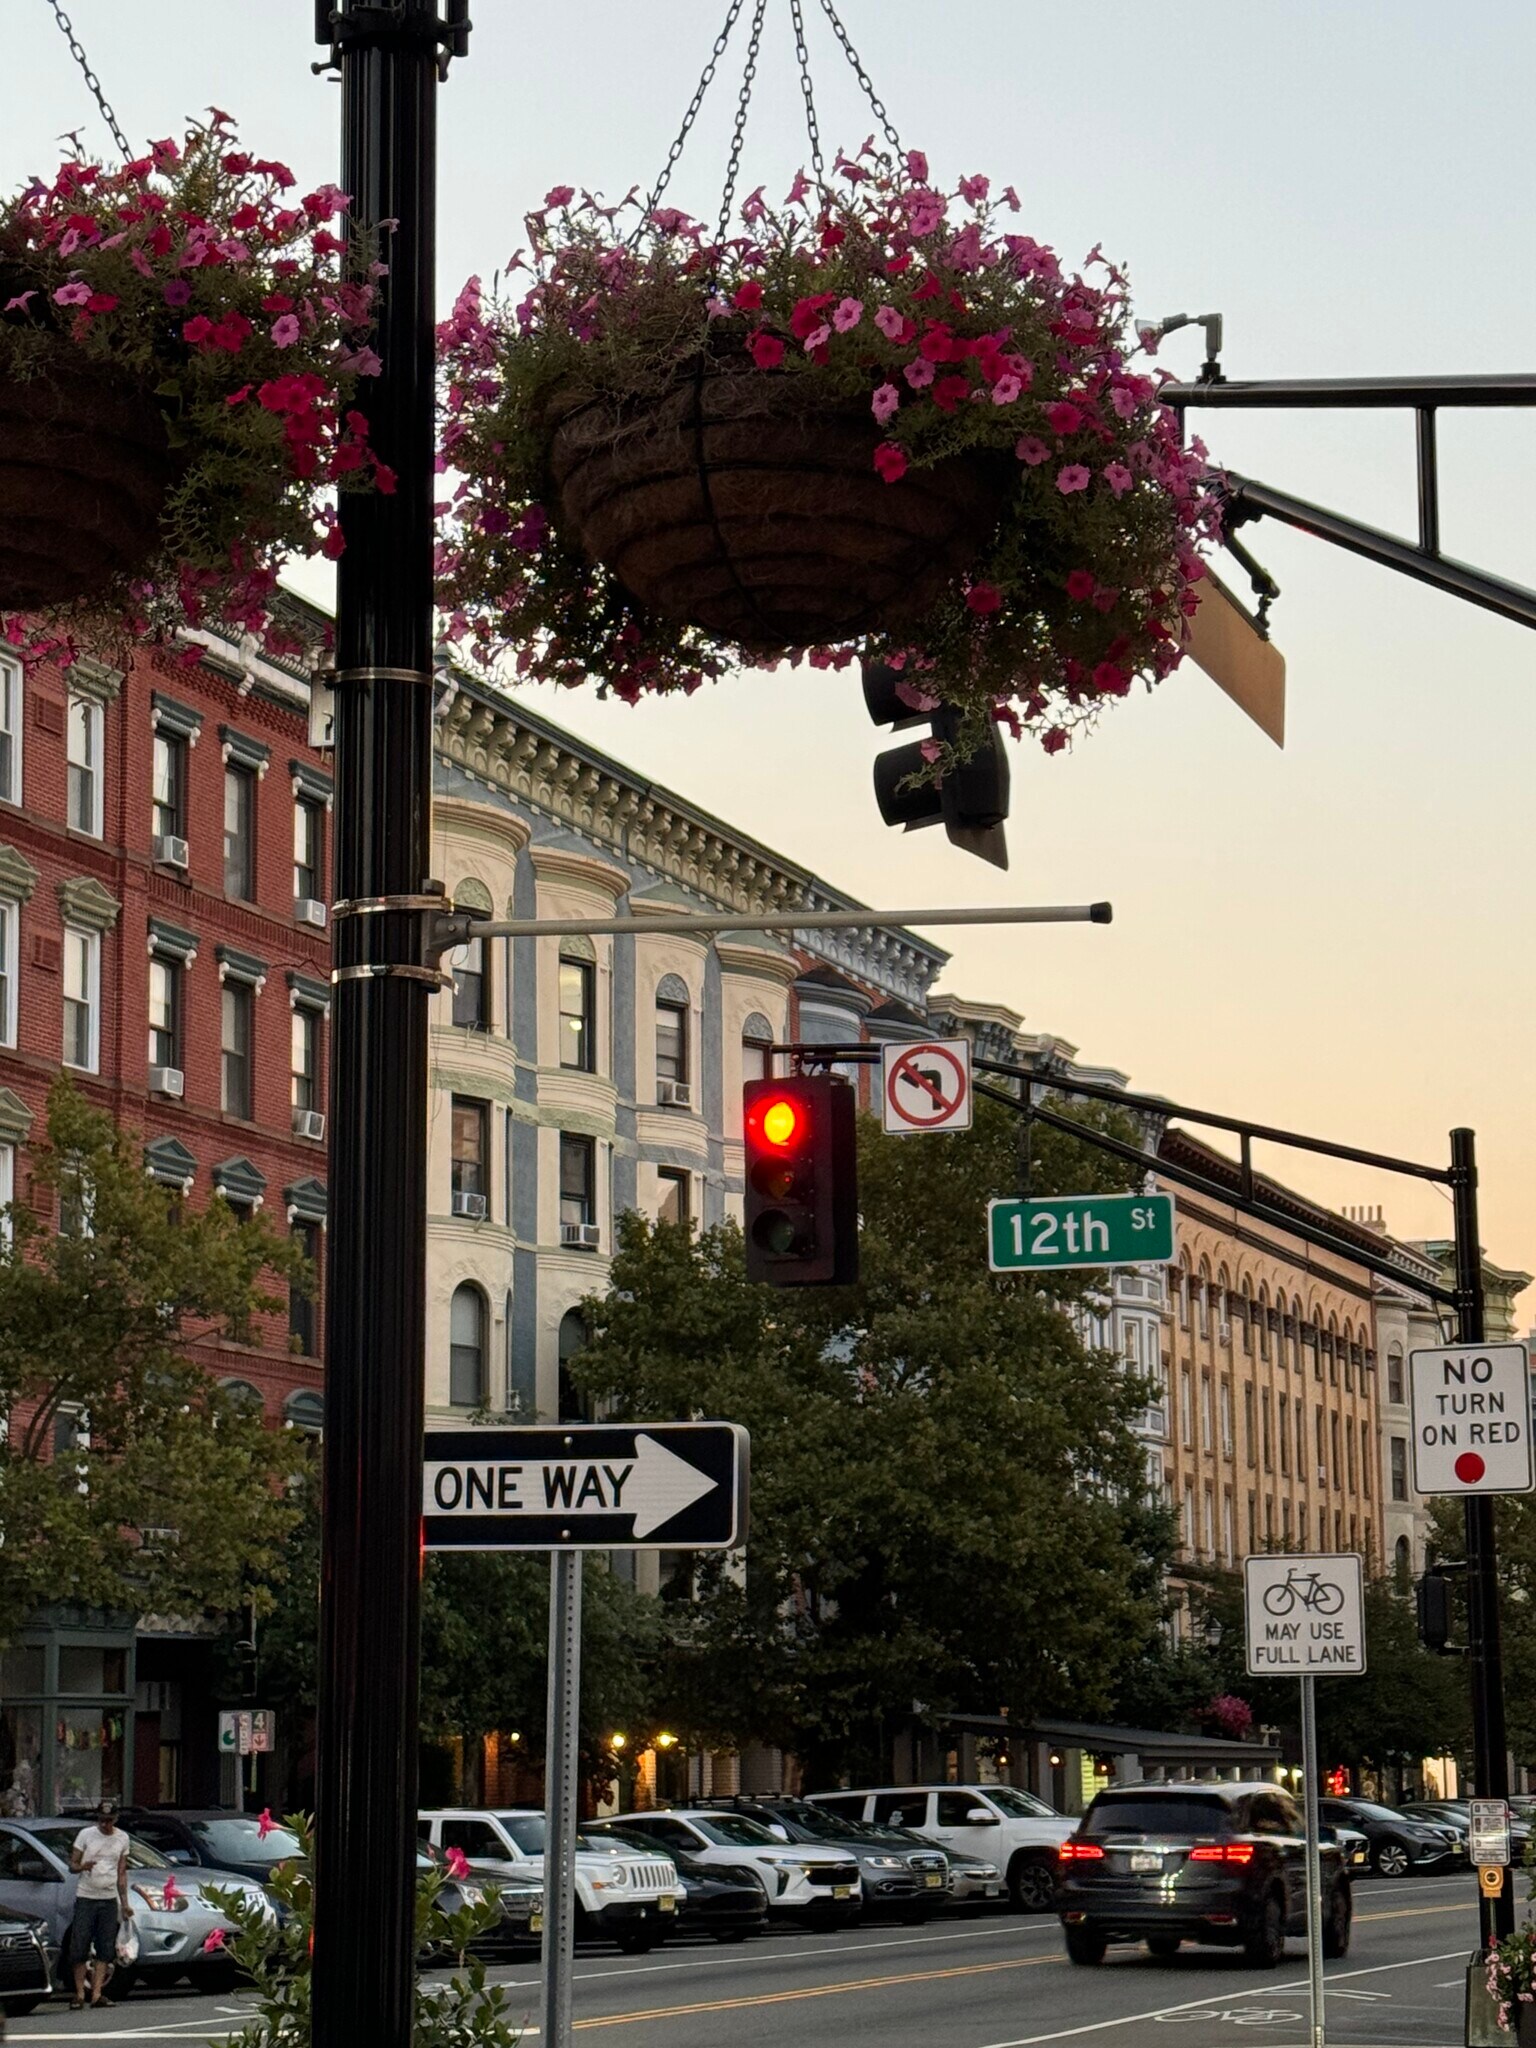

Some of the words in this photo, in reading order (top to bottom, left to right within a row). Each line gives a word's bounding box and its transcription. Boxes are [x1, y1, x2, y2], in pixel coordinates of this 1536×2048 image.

[1010, 1210, 1110, 1256] 12th
[1131, 1207, 1156, 1230] St
[1443, 1357, 1493, 1385] NO
[1435, 1391, 1505, 1416] TURN
[1422, 1424, 1457, 1446] ON
[1470, 1421, 1520, 1444] RED
[434, 1466, 523, 1510] ONE
[542, 1464, 634, 1509] WAY
[1265, 1622, 1302, 1641] MAY
[1310, 1622, 1345, 1640] USE
[1256, 1646, 1300, 1664] FULL
[1307, 1645, 1357, 1664] LANE
